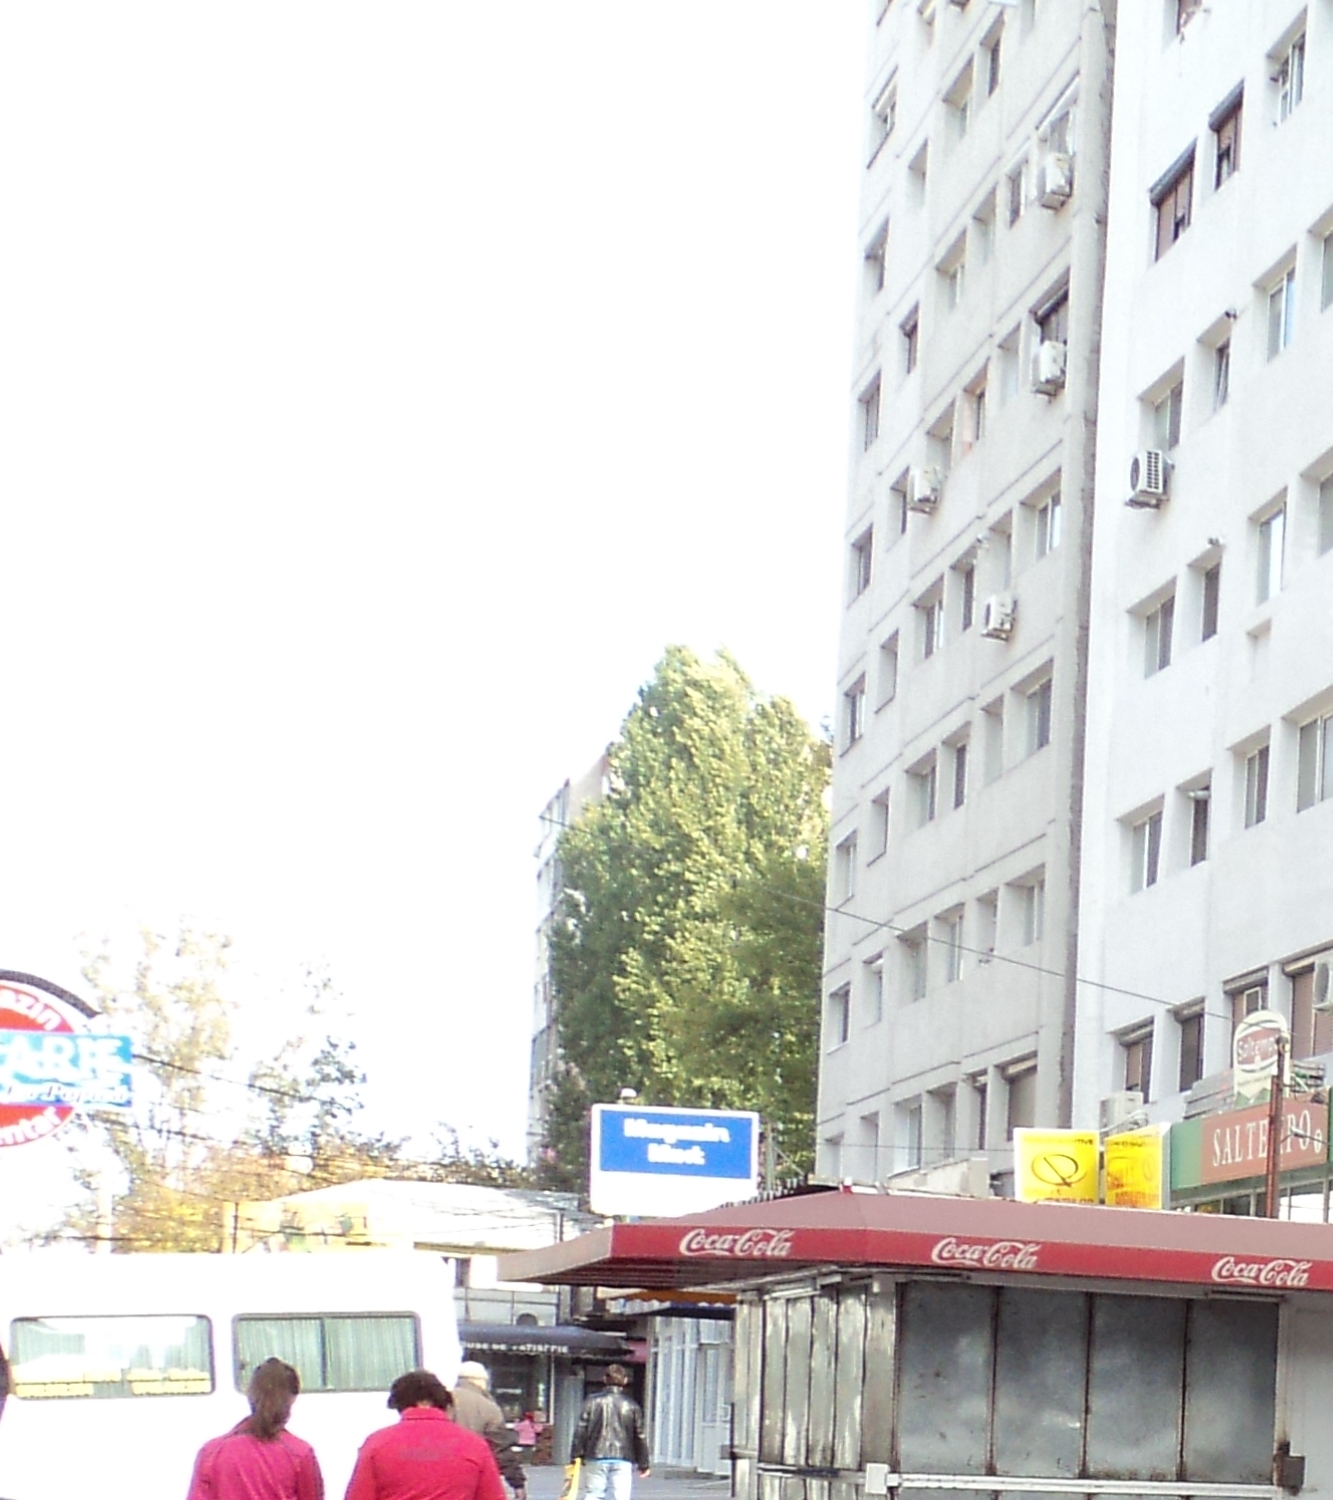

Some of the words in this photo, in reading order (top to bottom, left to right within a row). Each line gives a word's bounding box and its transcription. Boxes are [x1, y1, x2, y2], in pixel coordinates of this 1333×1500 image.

[1212, 1110, 1312, 1167] SALTEPO
[678, 1228, 796, 1257] Coca-Cola
[931, 1236, 1043, 1270] Coca-Cola
[1210, 1255, 1313, 1287] Coca-Cola
